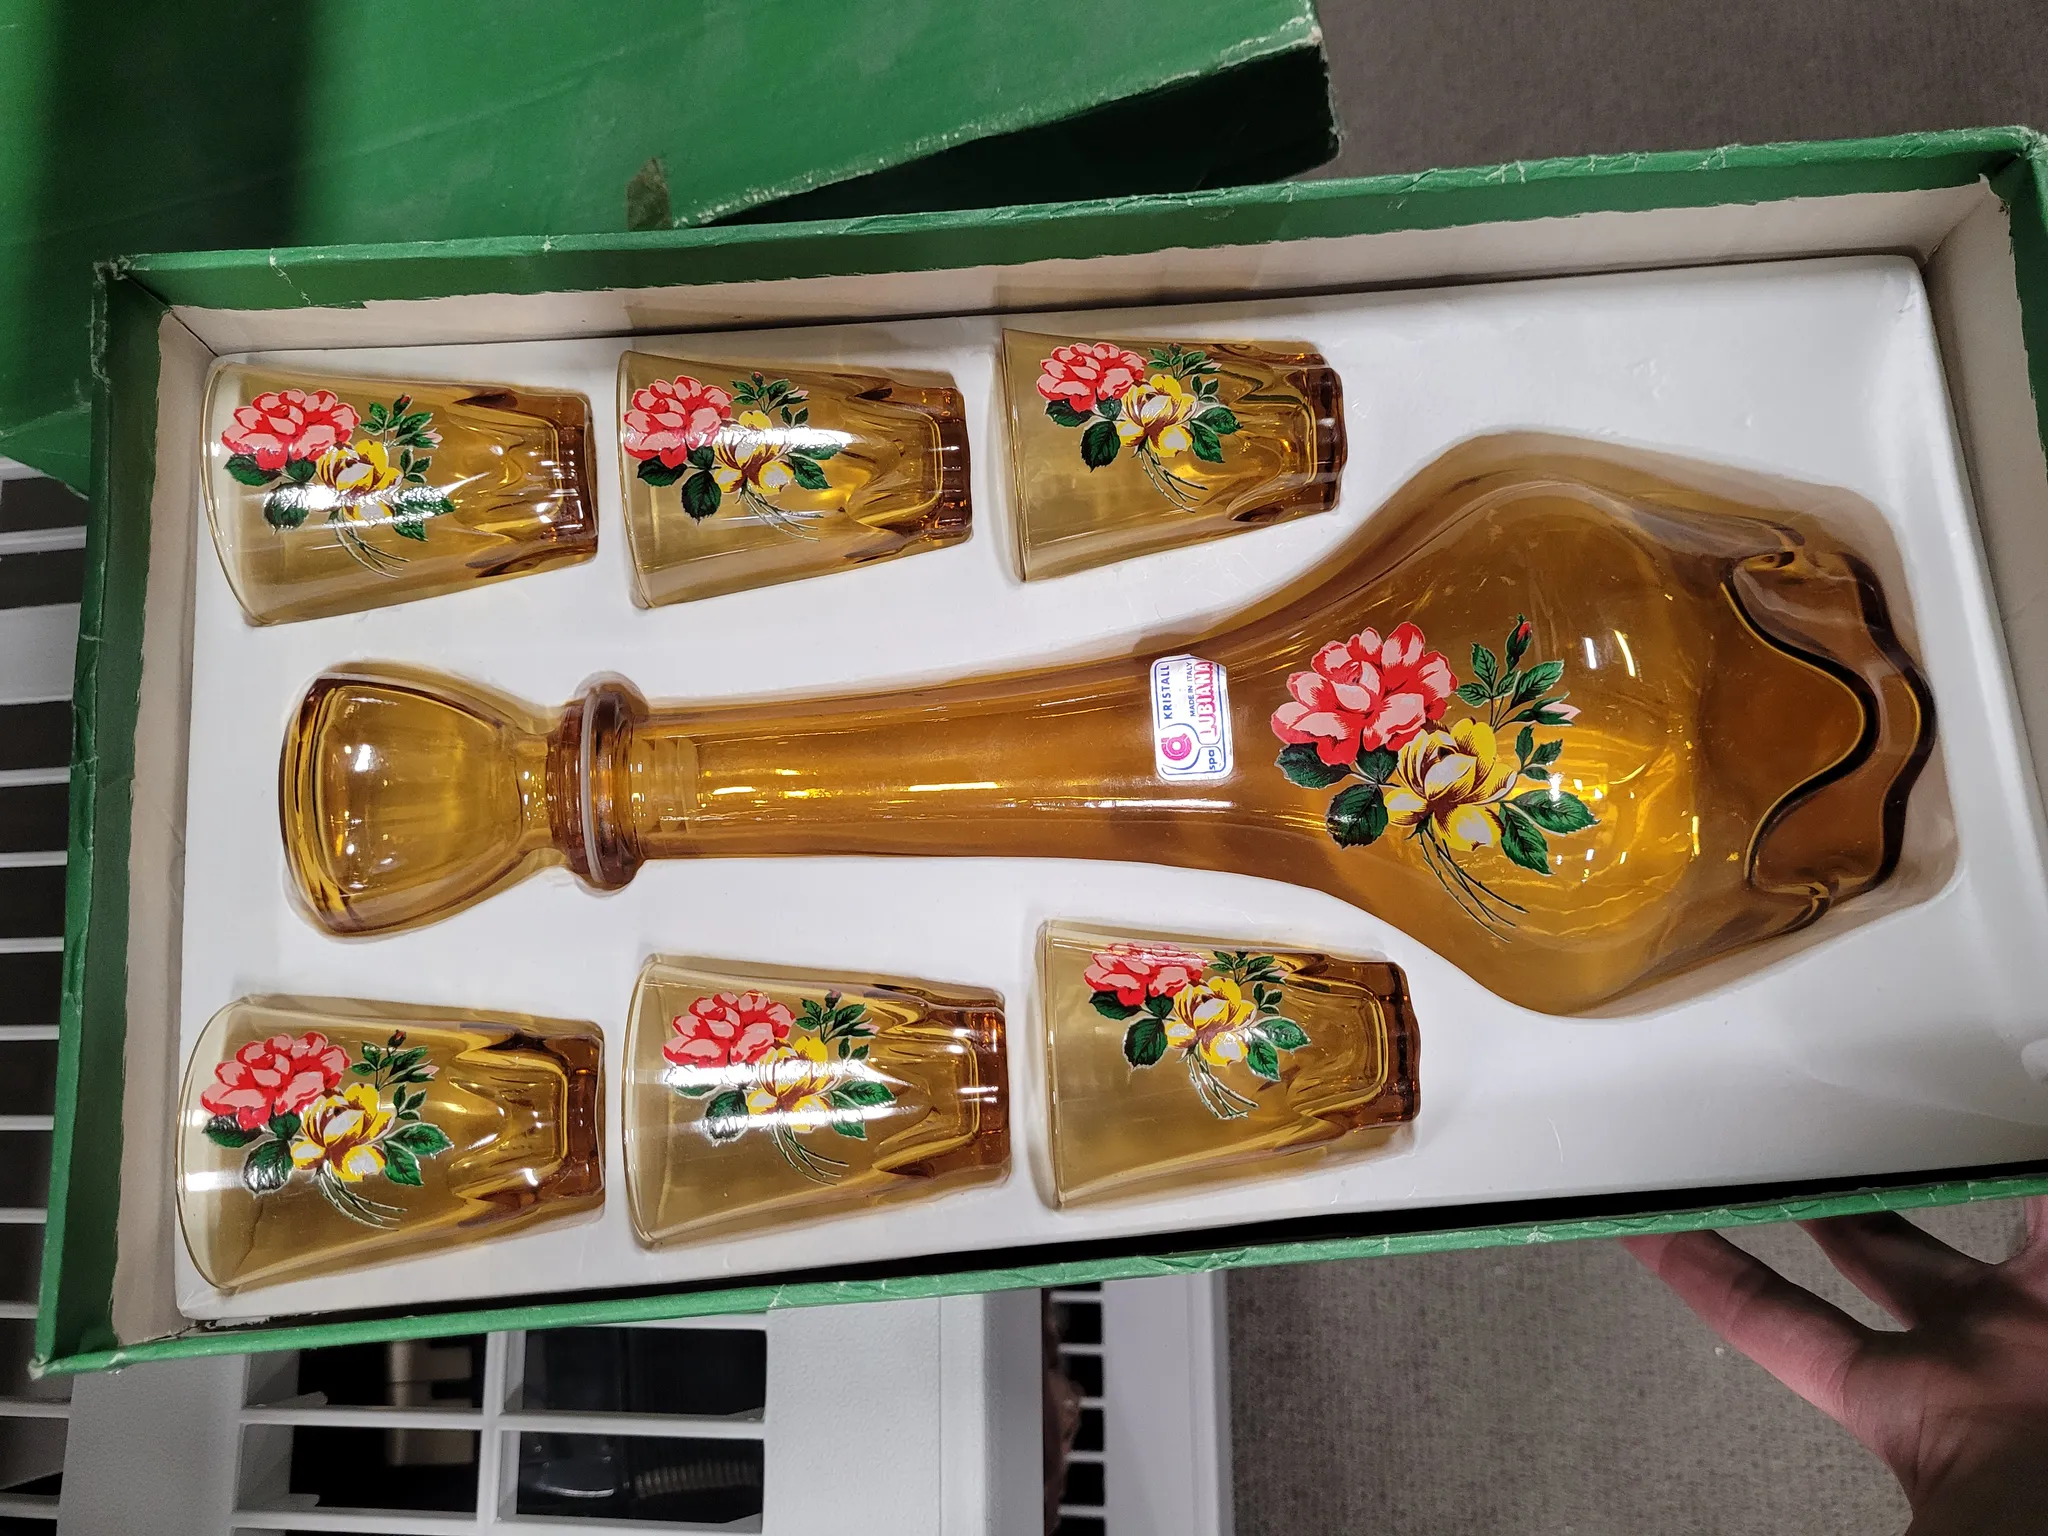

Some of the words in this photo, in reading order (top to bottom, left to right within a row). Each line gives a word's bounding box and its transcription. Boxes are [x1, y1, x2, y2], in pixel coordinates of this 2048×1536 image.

[1160, 664, 1173, 720] KRISTALL
[1187, 685, 1193, 693] IN
[1194, 661, 1217, 737] LUBIANA
[1188, 694, 1196, 717] MADE
[1208, 749, 1217, 770] spa
